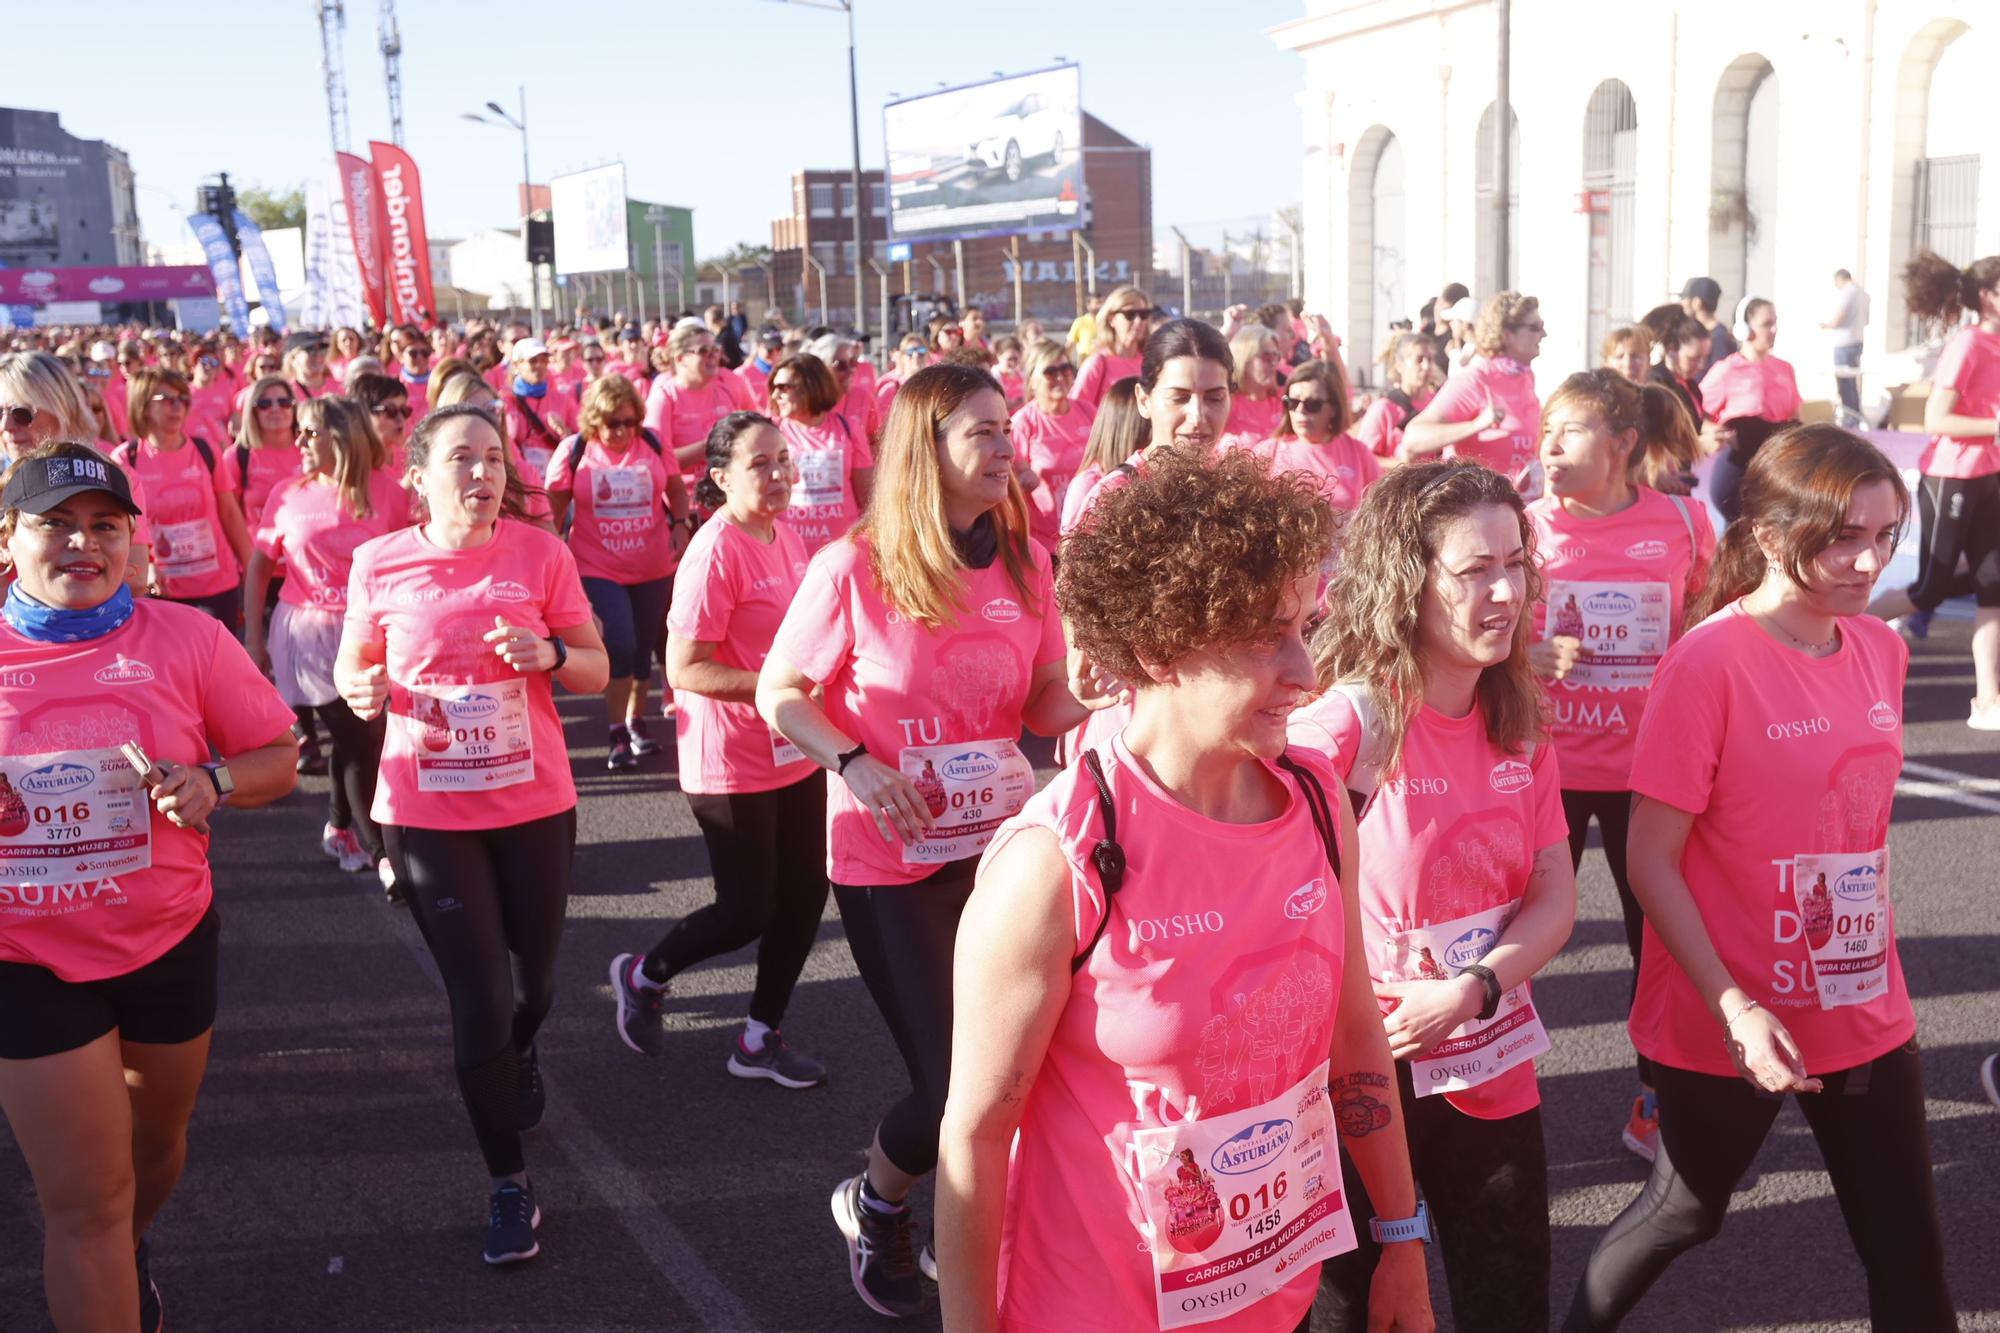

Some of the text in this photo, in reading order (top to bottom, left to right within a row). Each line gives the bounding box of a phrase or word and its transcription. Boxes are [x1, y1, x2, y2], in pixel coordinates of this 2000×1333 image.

[73, 459, 107, 482] BGR
[1588, 600, 1633, 611] ASTURIANA
[1588, 625, 1628, 639] 016
[100, 670, 151, 682] ASTURIANA
[451, 703, 496, 714] ASTURIANA
[455, 726, 496, 742] 016
[897, 717, 941, 745] TU
[1767, 716, 1830, 740] OYSHO
[465, 745, 490, 755] 1315
[101, 763, 132, 772] SUMA
[432, 760, 463, 768] CARRERA
[464, 760, 474, 768] DE
[948, 762, 996, 776] ASTURIANA
[26, 775, 90, 789] ASTURIANA
[429, 774, 465, 784] OYSHO
[952, 787, 993, 808] 016
[34, 802, 90, 823] 016
[962, 809, 982, 820] 430
[47, 826, 82, 840] 3770
[0, 848, 45, 856] CARRERA
[48, 848, 60, 856] DE
[78, 842, 110, 853] MUJER
[114, 839, 135, 848] 2023
[916, 844, 957, 854] OYSHO
[89, 855, 140, 870] Santander
[51, 907, 62, 916] LA
[64, 901, 94, 914] MUJER
[105, 896, 128, 906] 2023
[1138, 911, 1223, 942] OYSHO
[1836, 913, 1875, 935] 016
[1844, 939, 1868, 954] 1460
[1840, 963, 1850, 971] DE
[1852, 961, 1861, 969] LA
[1430, 1039, 1477, 1055] CARRERA
[1478, 1033, 1488, 1044] DE
[1487, 1031, 1494, 1040] LA
[1494, 1019, 1512, 1037] MUJER
[1430, 1031, 1536, 1081] OYSHO Santander
[1126, 1079, 1197, 1127] TU
[1220, 1130, 1289, 1170] ASTURIANA
[1230, 1170, 1287, 1220] 016
[1245, 1209, 1281, 1239] 1458
[1185, 1203, 1328, 1283] CARRERA DE LA MUJER 2023
[1181, 1227, 1337, 1312] OYSHO Santander
